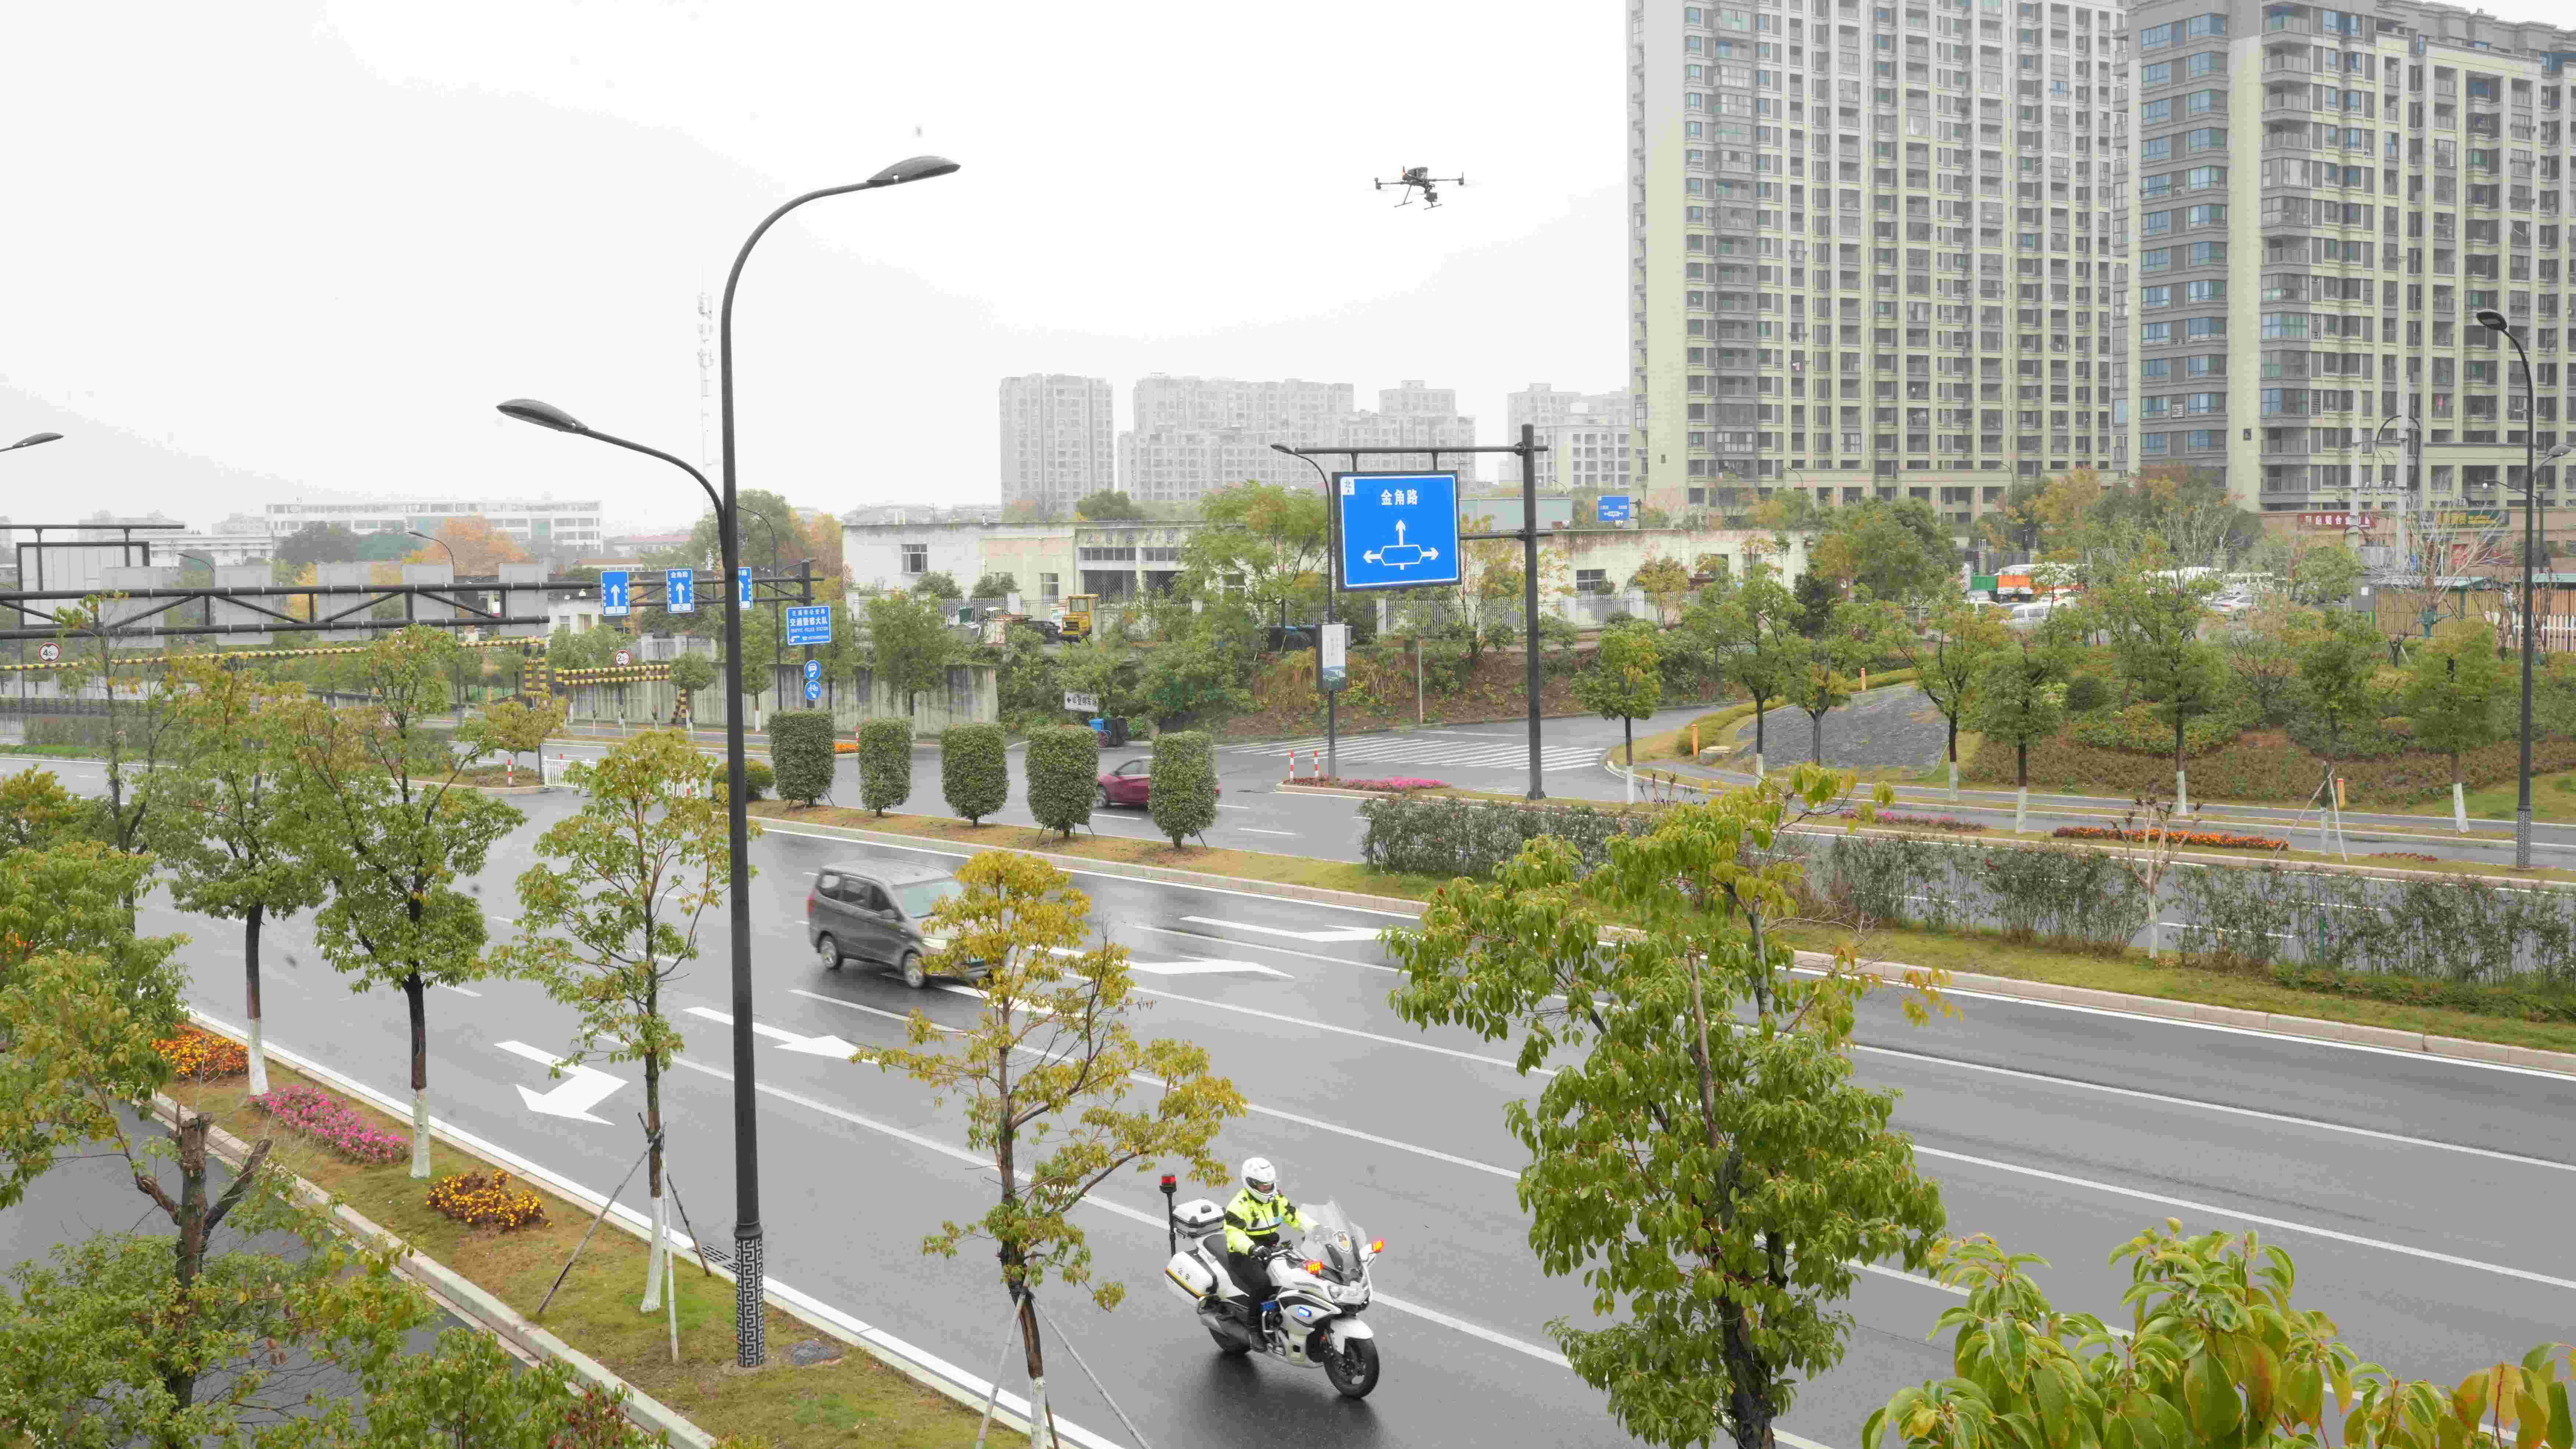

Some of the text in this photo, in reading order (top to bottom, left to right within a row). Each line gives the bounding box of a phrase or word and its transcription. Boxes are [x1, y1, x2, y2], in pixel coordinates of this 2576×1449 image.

[1345, 479, 1351, 488] 北
[1381, 489, 1417, 505] 金角路
